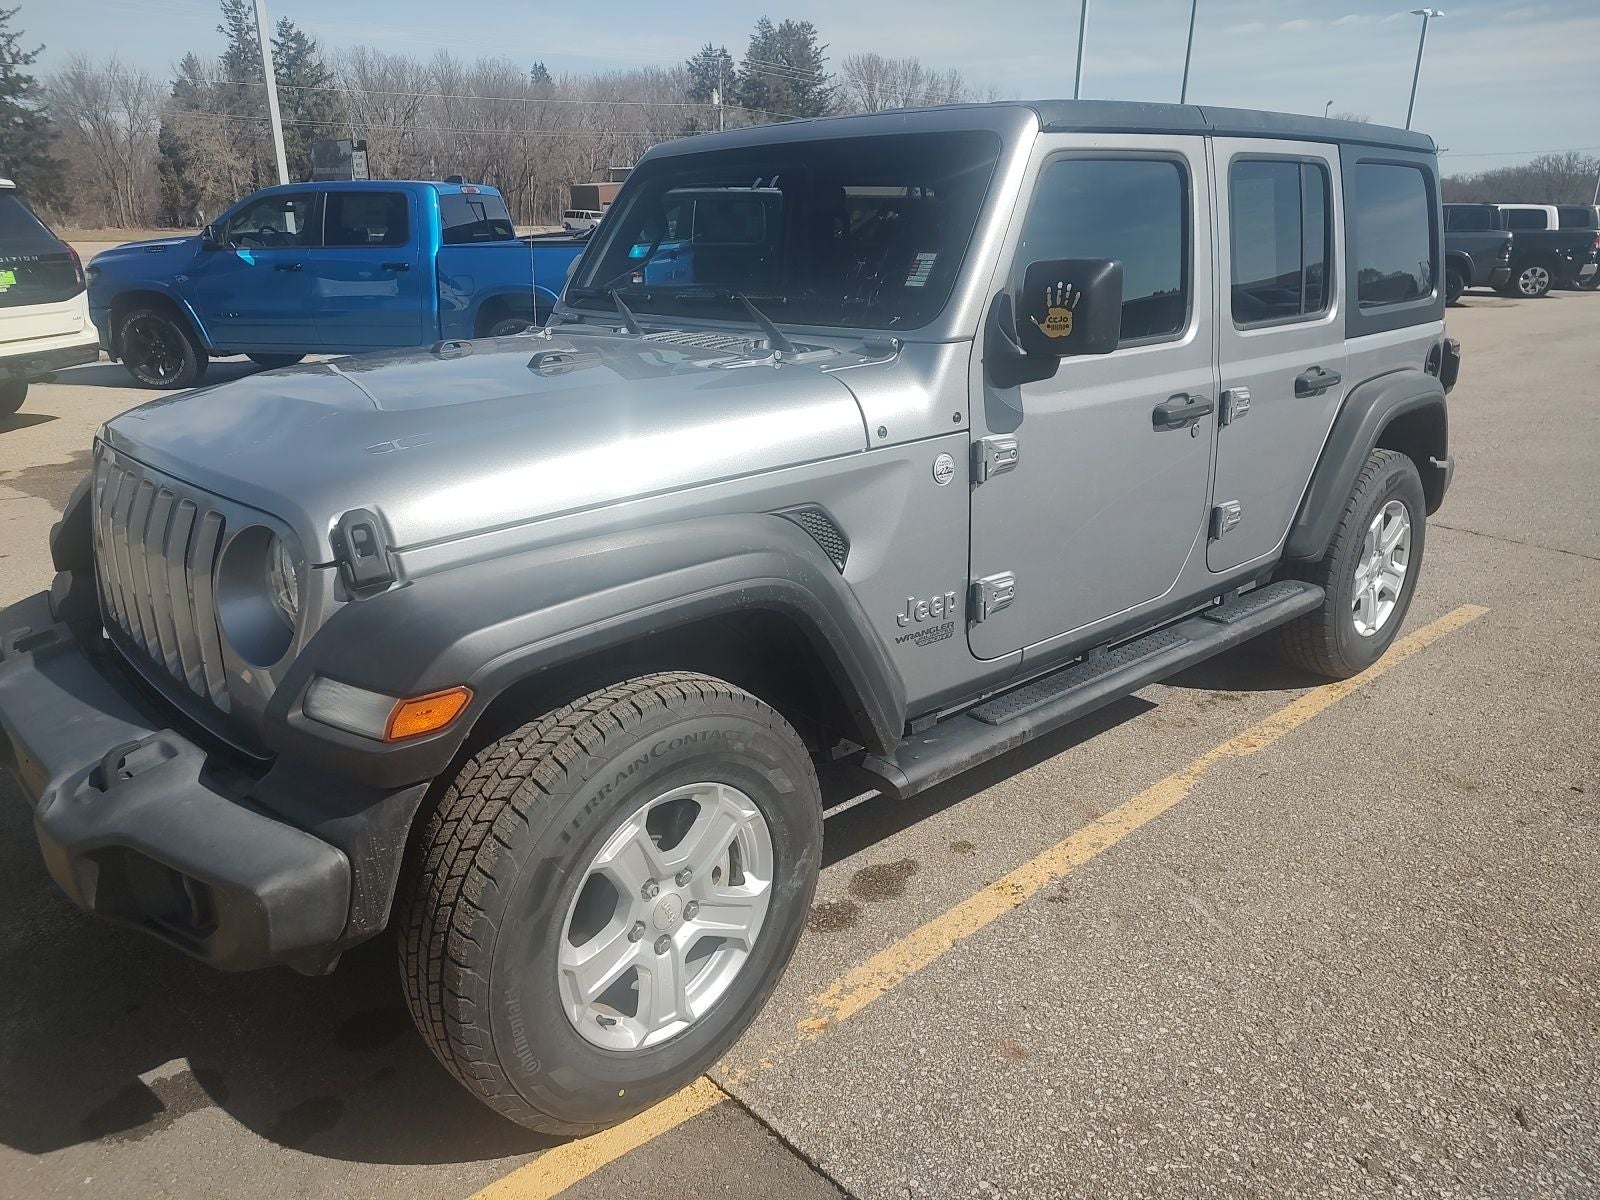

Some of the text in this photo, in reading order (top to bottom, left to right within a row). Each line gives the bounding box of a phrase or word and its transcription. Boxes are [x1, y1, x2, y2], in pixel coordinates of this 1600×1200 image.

[1048, 316, 1069, 324] CCJO
[896, 591, 957, 628] Jeep
[894, 621, 955, 645] WRANGLER
